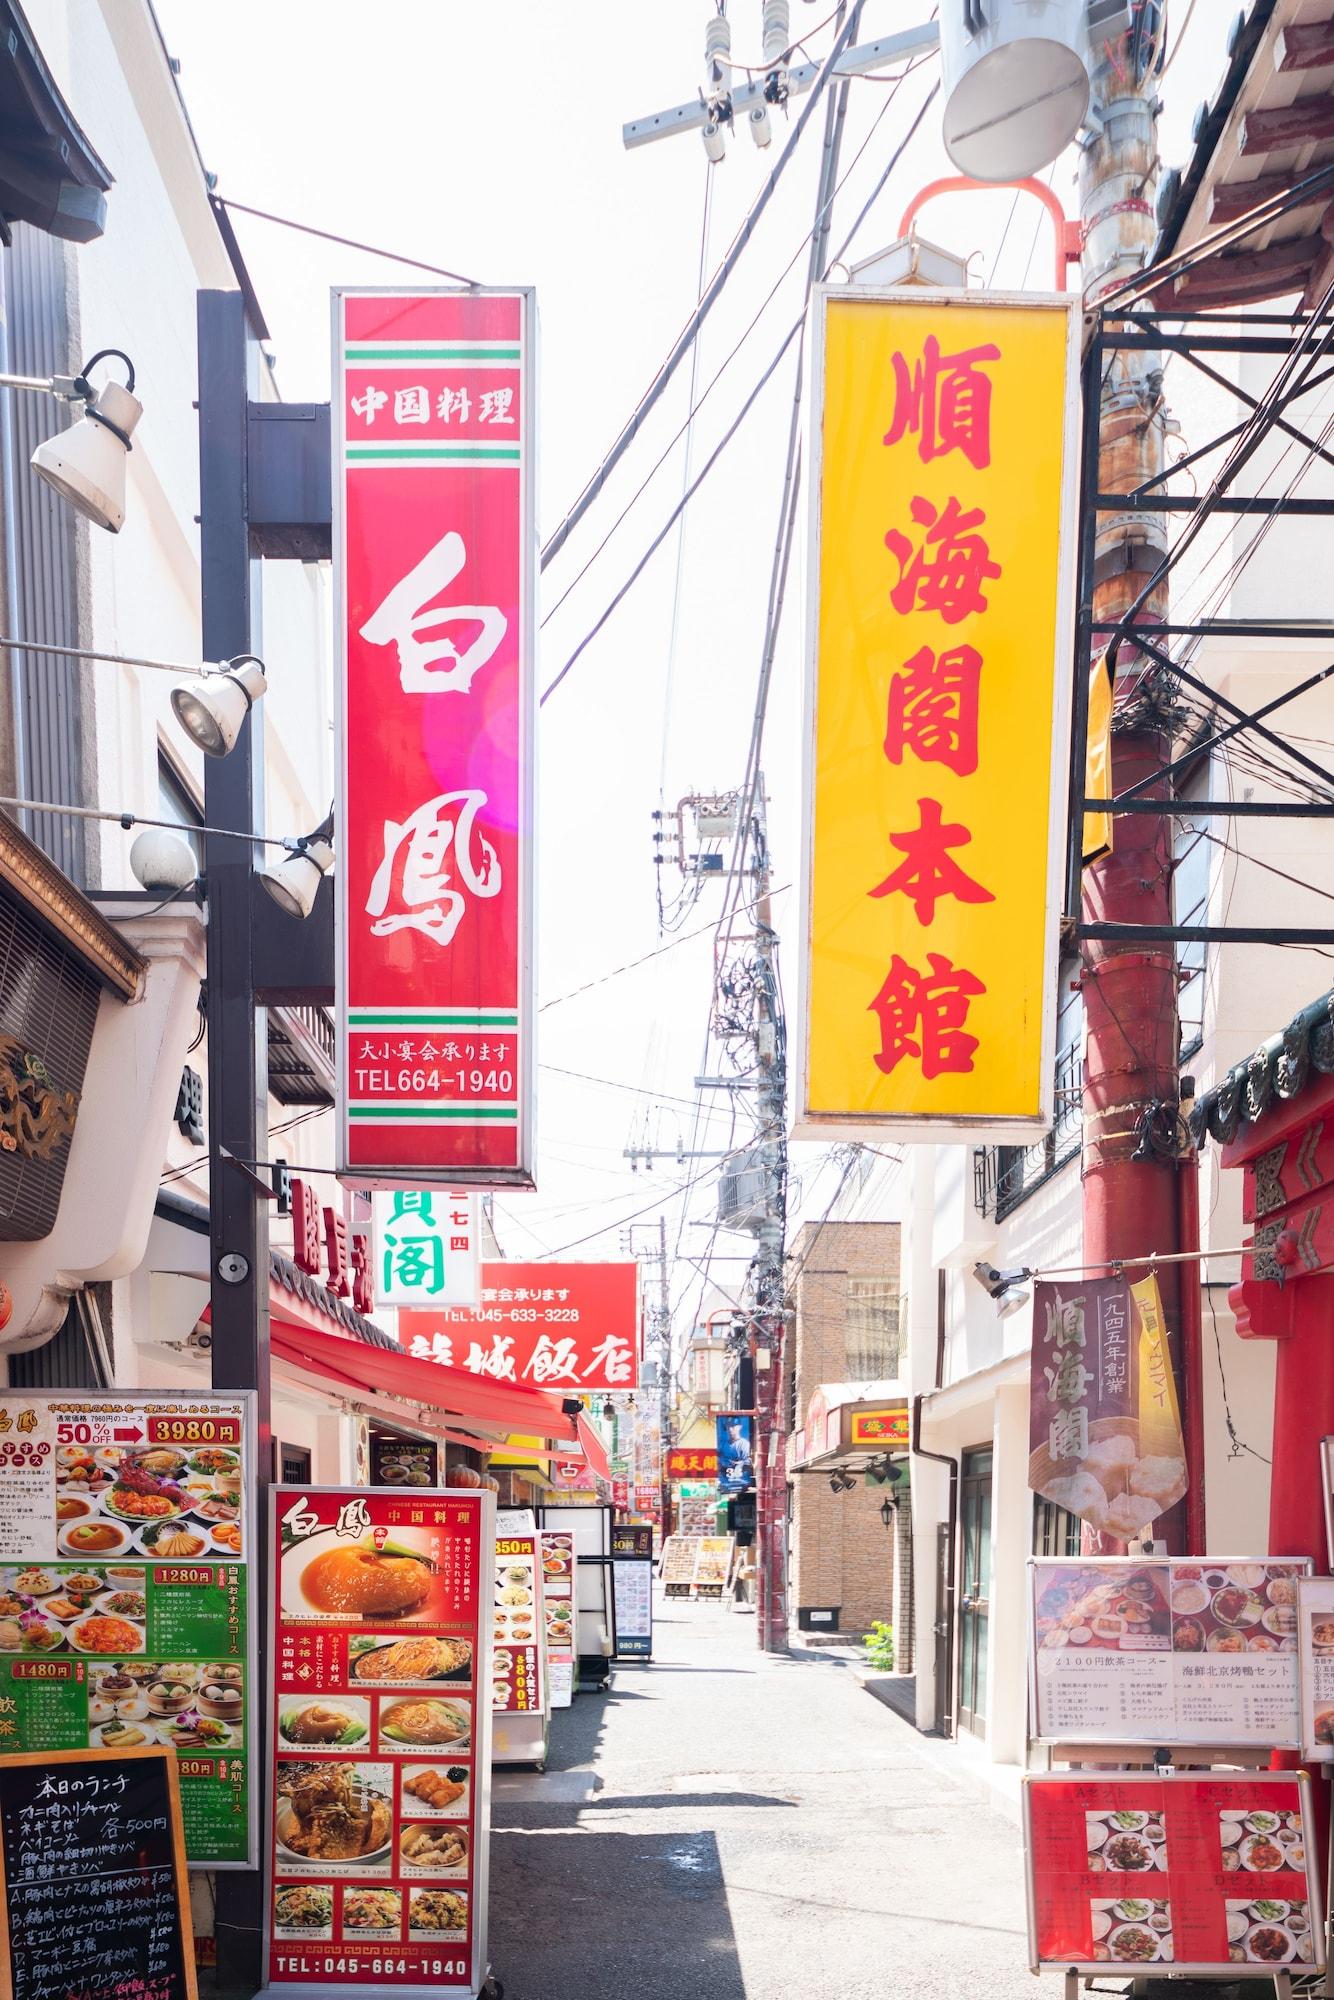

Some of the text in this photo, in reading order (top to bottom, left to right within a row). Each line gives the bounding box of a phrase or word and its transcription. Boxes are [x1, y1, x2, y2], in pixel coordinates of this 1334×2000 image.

[350, 385, 515, 426] 中国料理
[868, 334, 1002, 1081] 順海閣本館
[358, 531, 508, 947] 白鳳
[359, 1040, 510, 1062] 大小宴会承ります
[355, 1069, 513, 1092] TEL664-1940
[1103, 1294, 1127, 1394] 一九四五年創業
[1044, 1286, 1095, 1462] 順海閣
[93, 1436, 111, 1444] OFF
[156, 1421, 234, 1441] 3980円
[281, 1496, 371, 1539] 白鳳
[388, 1510, 471, 1524] 中国料理
[161, 1569, 209, 1582] 1280円
[228, 1566, 240, 1654] 白鳳おすすめコース
[19, 1663, 68, 1677] 1480円
[281, 1636, 295, 1681] 中国料理
[316, 1635, 324, 1688] 素材にこだわる
[178, 1762, 210, 1775] 80円
[33, 1774, 130, 1800] 本日のランチ
[230, 1760, 244, 1812] 美肌コース
[20, 1818, 80, 1837] ネギそば
[277, 1956, 467, 1976] TEL:045-664-1940
